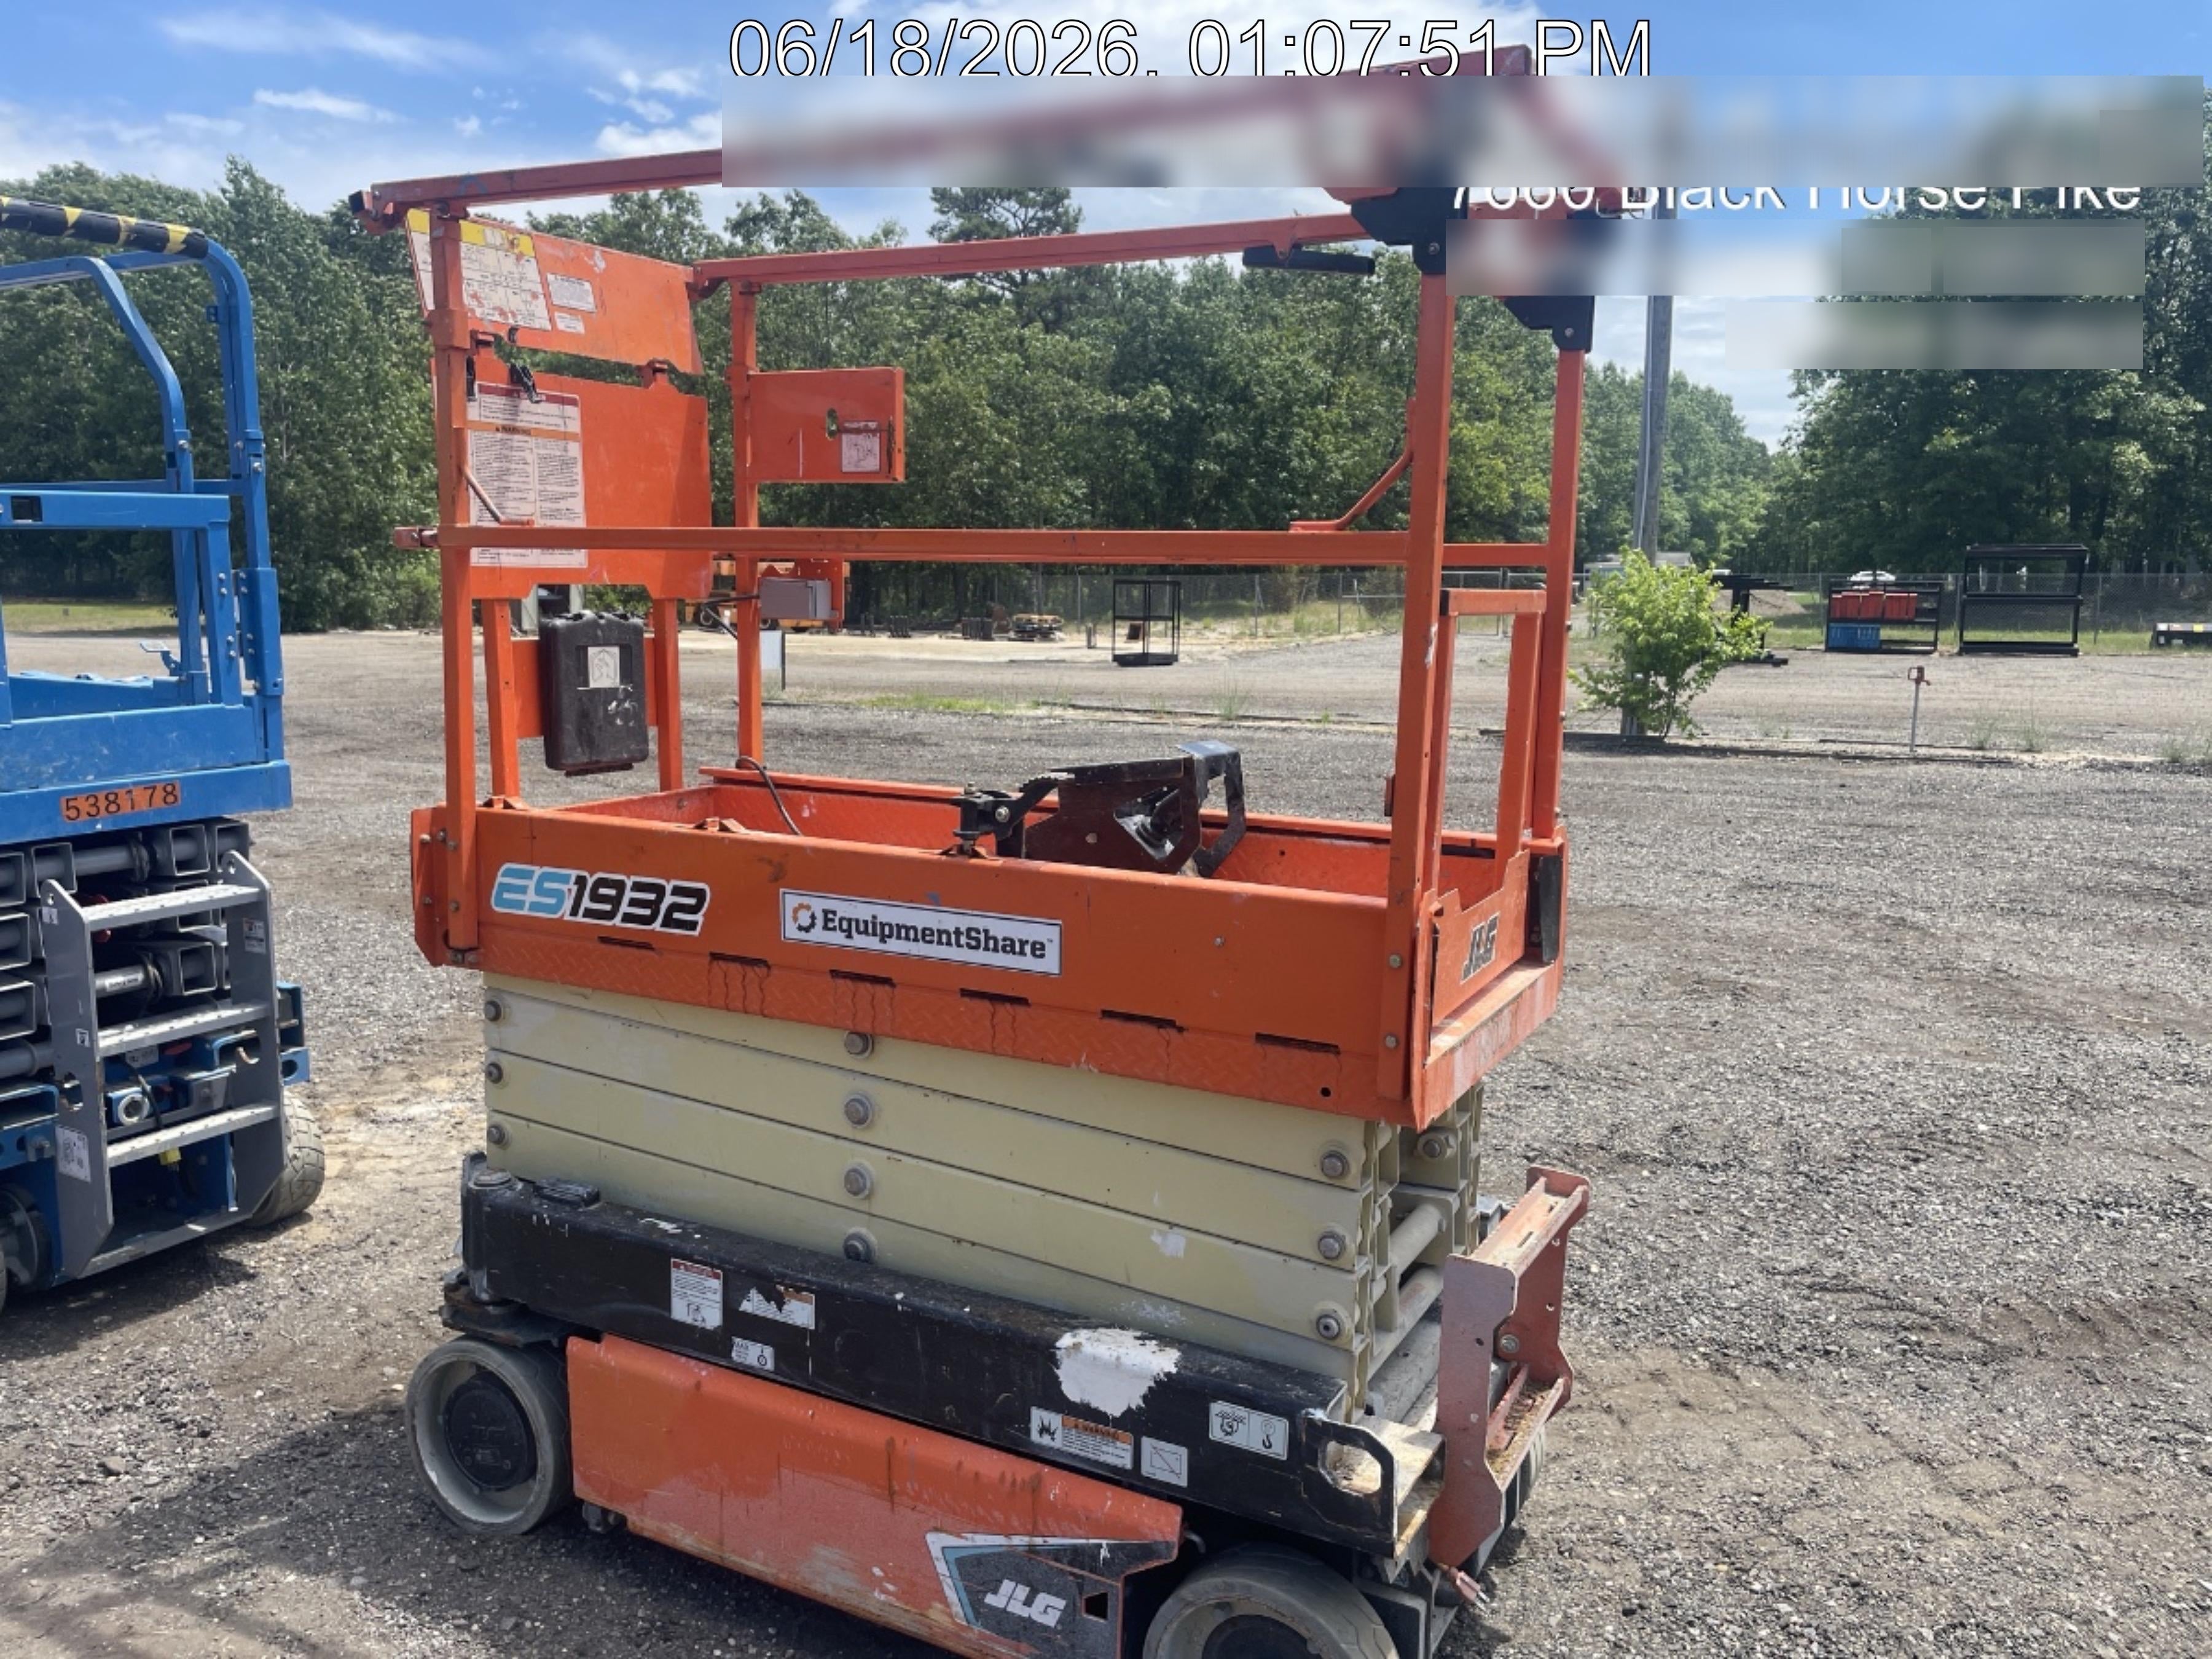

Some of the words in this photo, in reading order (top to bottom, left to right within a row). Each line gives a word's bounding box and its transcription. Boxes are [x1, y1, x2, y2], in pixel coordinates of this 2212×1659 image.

[65, 782, 178, 821] 538178
[492, 865, 709, 934] ES1932
[821, 908, 1047, 959] EquipmentShare
[984, 1579, 1067, 1628] JLG
